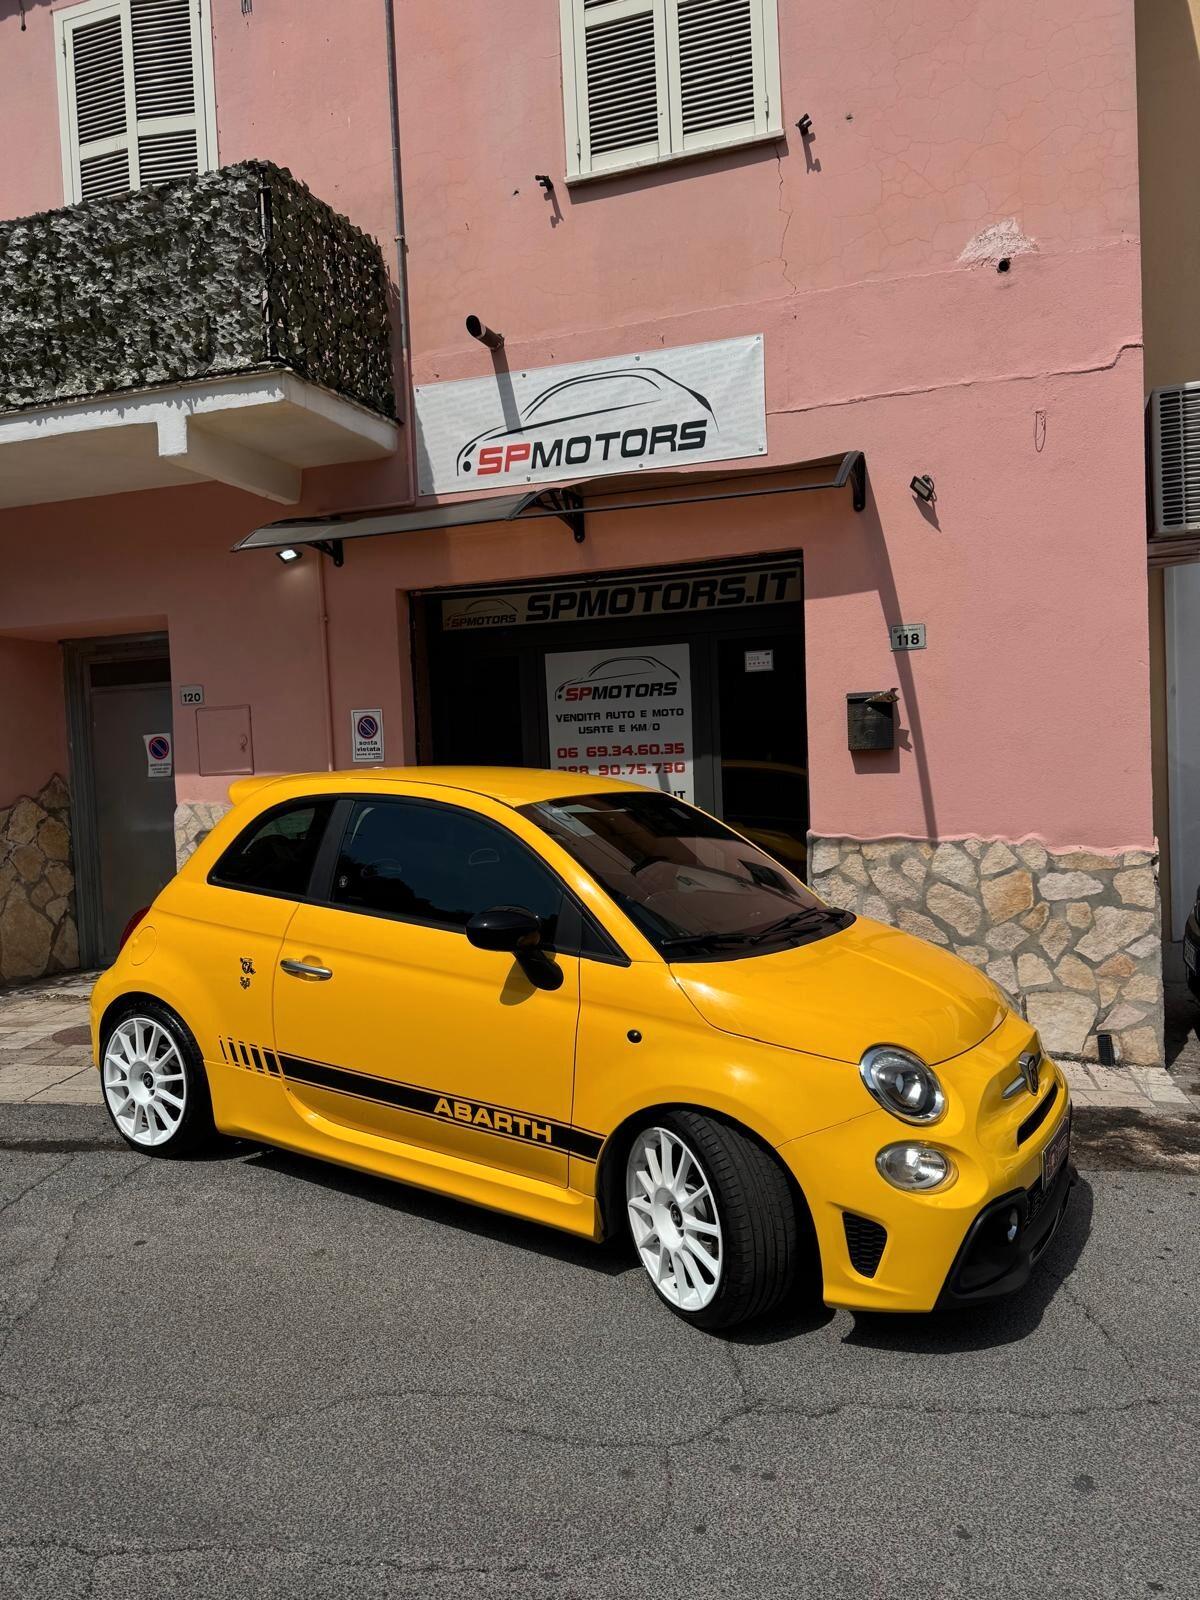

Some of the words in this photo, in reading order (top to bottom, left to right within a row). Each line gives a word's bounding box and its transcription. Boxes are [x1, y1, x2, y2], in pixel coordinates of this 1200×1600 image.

[477, 419, 708, 475] SPMOTORS
[525, 570, 798, 622] SPMOTORS.IT
[451, 614, 517, 628] SPMOTORS
[897, 633, 919, 646] 118
[183, 693, 201, 702] 120
[565, 681, 678, 702] SPMOTORS
[556, 712, 601, 722] VENDITA
[606, 710, 635, 720] AUTO
[640, 710, 647, 718] E
[652, 708, 685, 717] MOTO
[578, 725, 614, 734] USATE
[619, 724, 626, 732] E
[557, 747, 578, 759] 06
[586, 743, 685, 757] 69.34.60.35
[598, 762, 686, 775] 90.75.730
[434, 1097, 552, 1143] ABARTH
